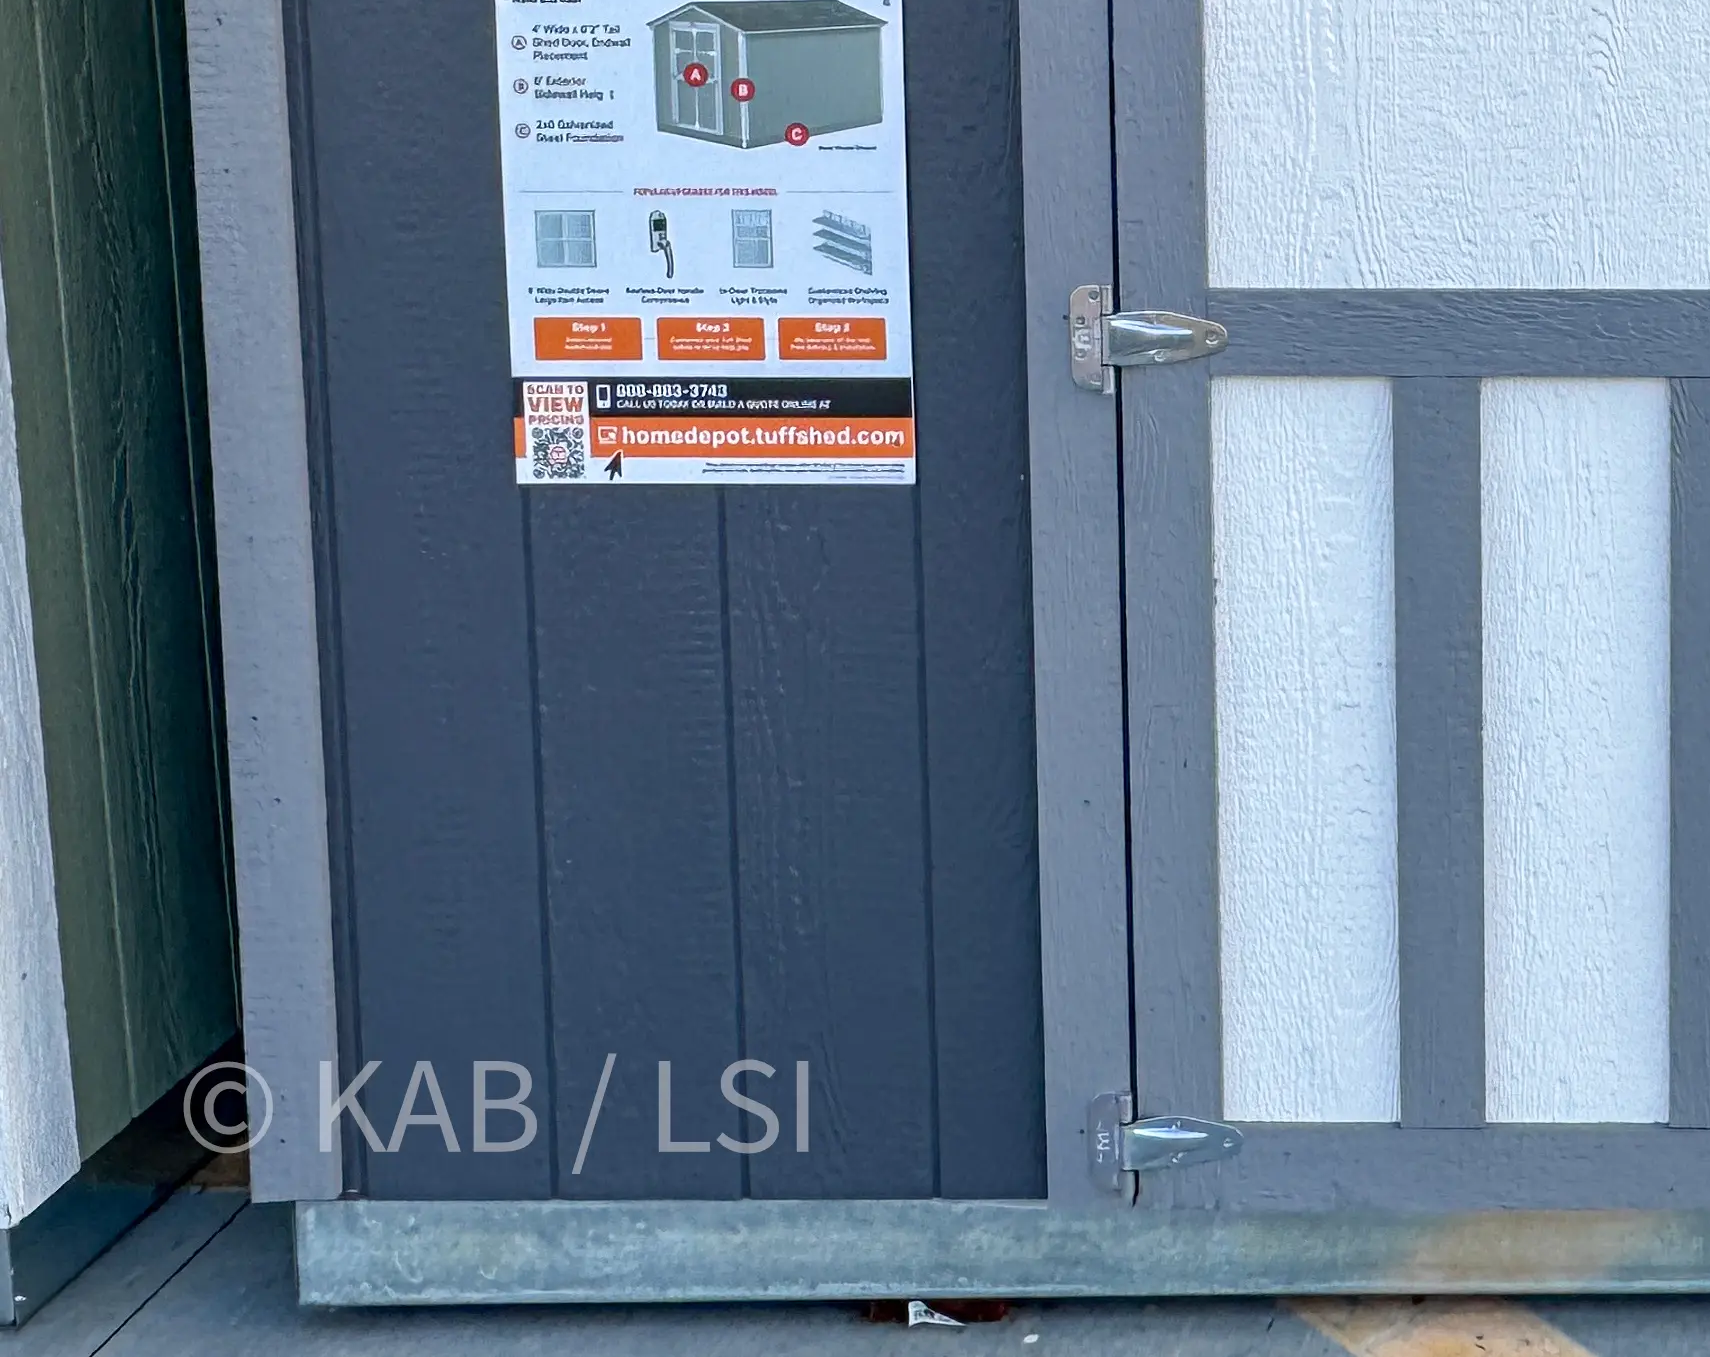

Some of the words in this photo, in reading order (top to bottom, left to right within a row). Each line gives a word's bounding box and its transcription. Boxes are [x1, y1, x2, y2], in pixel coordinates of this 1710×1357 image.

[567, 384, 584, 395] TO
[527, 396, 584, 413] VIEW
[616, 400, 641, 409] CALL
[622, 425, 906, 449] homedepot.tuffshed.com
